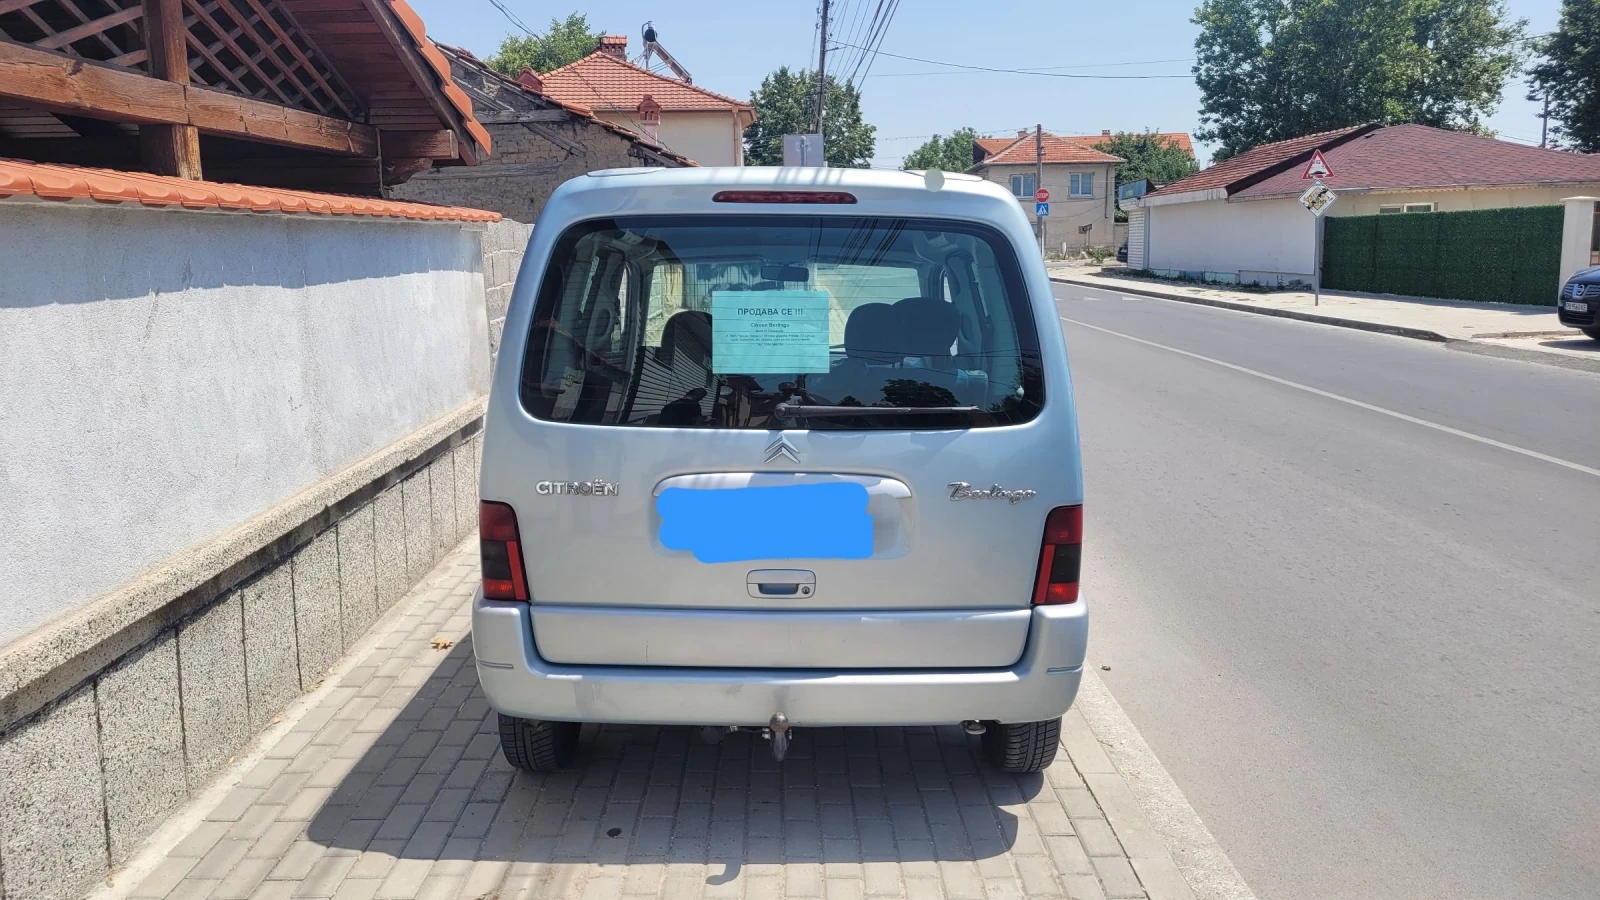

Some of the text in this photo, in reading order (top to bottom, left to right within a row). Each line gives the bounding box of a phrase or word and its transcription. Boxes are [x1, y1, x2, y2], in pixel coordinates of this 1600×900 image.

[737, 308, 803, 316] ПРОДАВА СЕ !!!
[535, 479, 619, 496] CITROËN
[947, 481, 1037, 504] Berlingo
